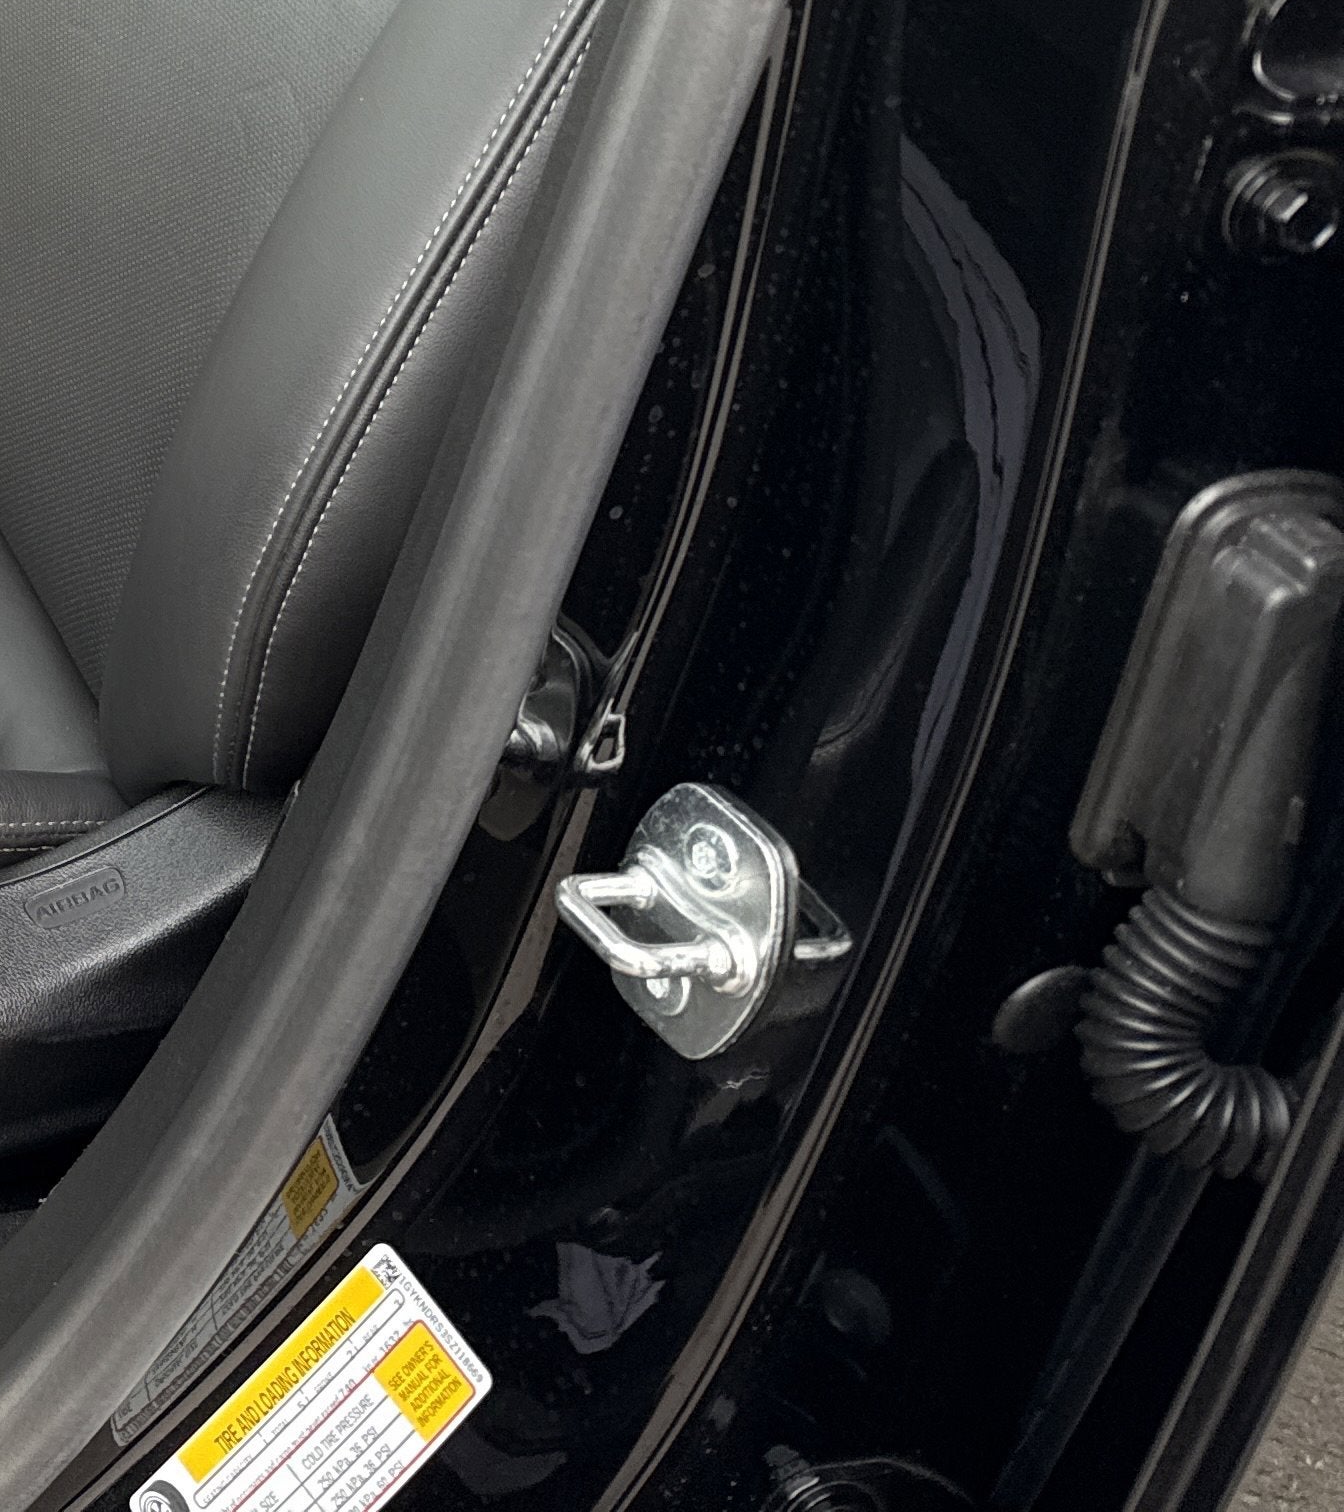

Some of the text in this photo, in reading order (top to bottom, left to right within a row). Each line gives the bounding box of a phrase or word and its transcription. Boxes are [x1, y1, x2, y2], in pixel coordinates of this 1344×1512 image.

[34, 878, 121, 921] AIRBAG
[214, 1308, 356, 1454] TIRE AND LOADING INFORMATION
[388, 1371, 404, 1392] SEE
[398, 1353, 444, 1402] MANUAL FOR
[410, 1369, 451, 1412] ADDITIONAL
[416, 1377, 462, 1427] INFORMATION
[259, 1393, 374, 1512] SIZE COLD TIRE PRESSURE
[361, 1426, 379, 1446] PSI
[375, 1443, 392, 1462] PSI
